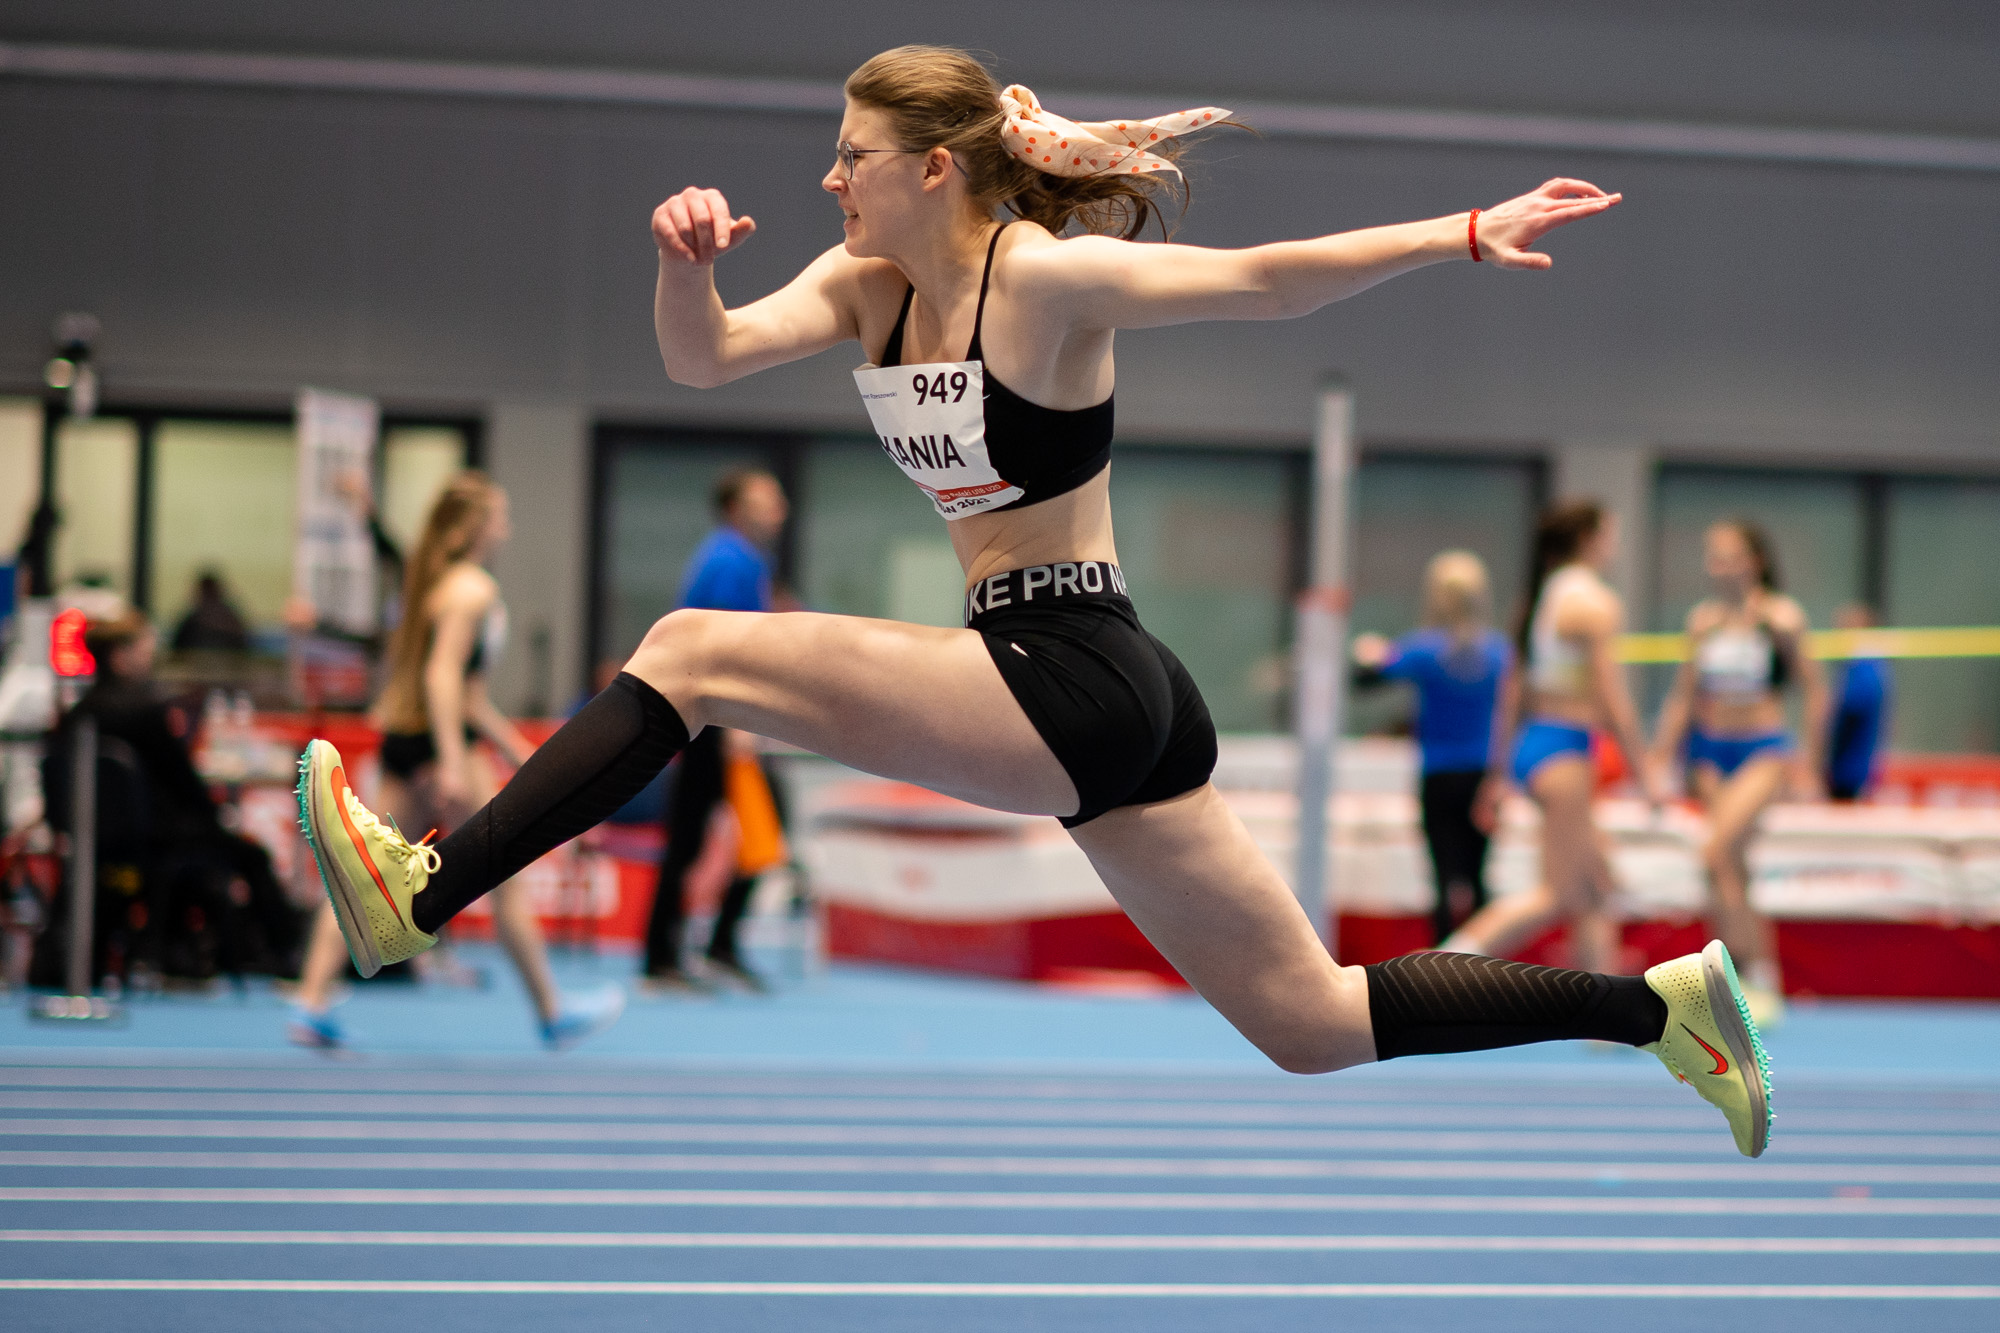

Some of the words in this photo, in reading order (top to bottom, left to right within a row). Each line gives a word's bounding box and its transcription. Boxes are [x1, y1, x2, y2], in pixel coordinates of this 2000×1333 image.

[912, 371, 968, 406] 949
[881, 434, 967, 470] KANIA
[1023, 561, 1104, 601] PRO
